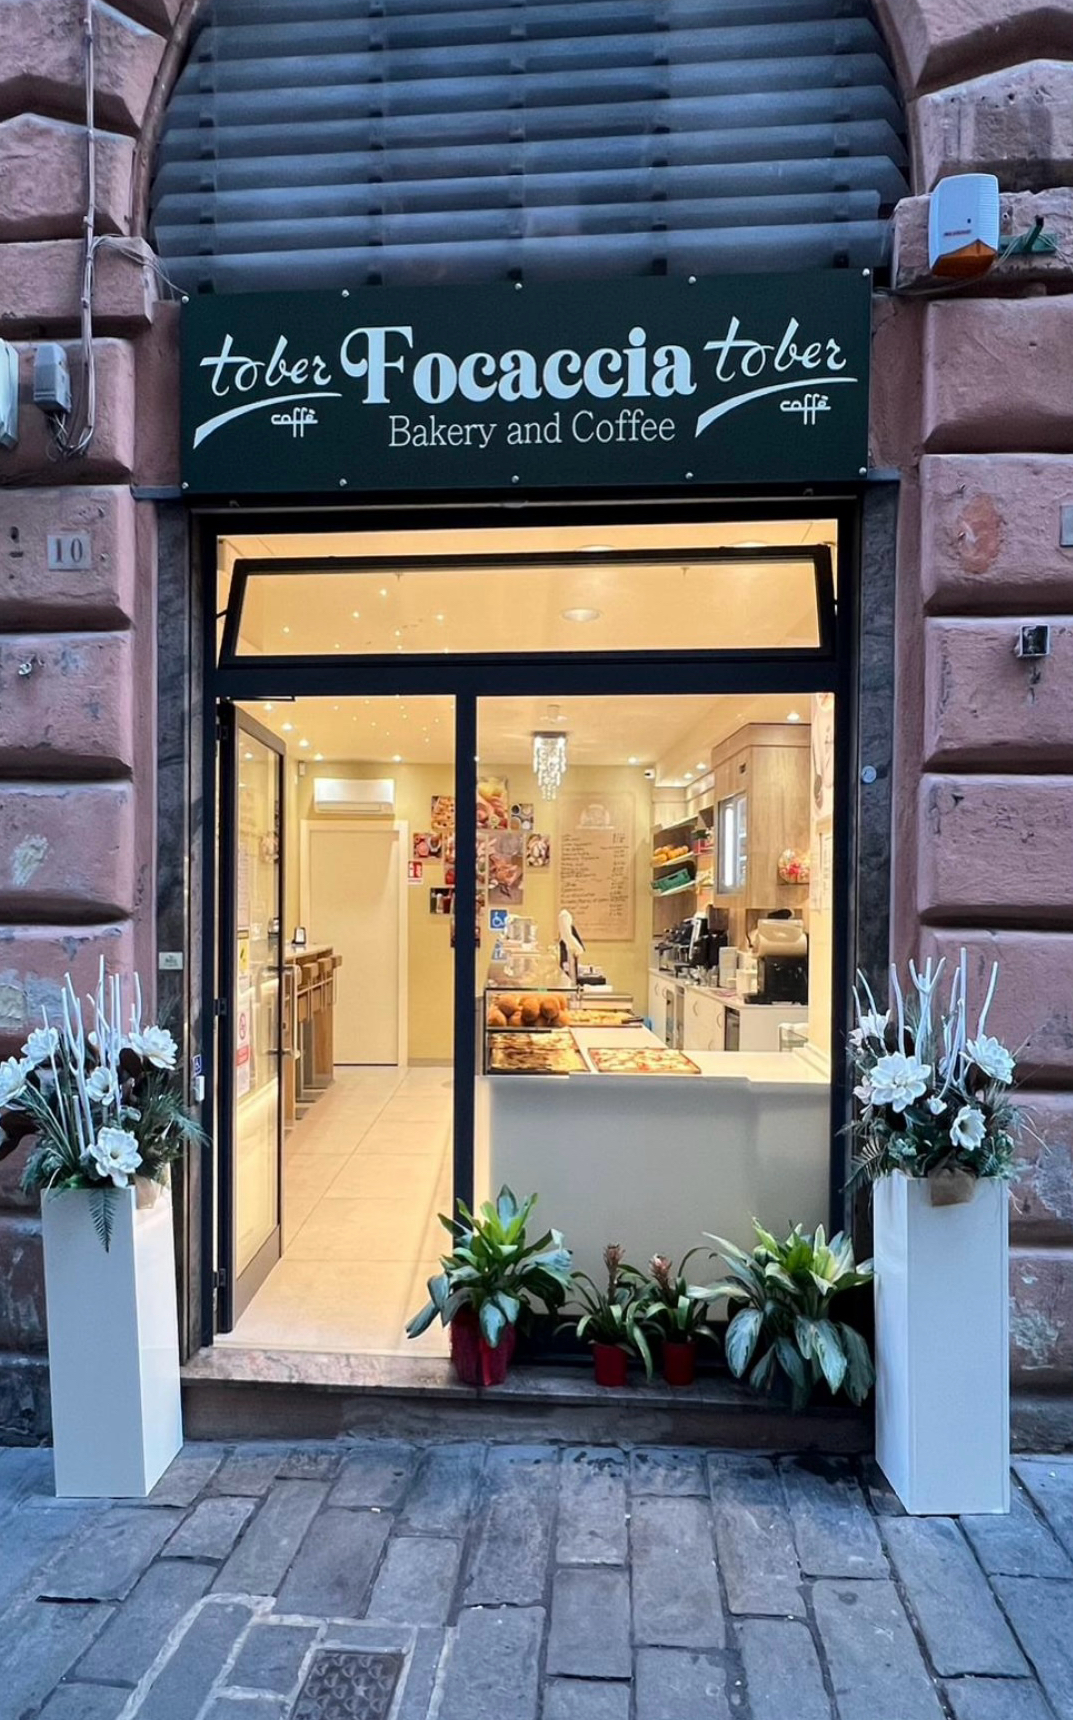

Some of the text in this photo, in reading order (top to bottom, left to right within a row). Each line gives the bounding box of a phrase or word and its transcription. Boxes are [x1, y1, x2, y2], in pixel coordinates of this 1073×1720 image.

[199, 333, 332, 397] tober
[339, 325, 698, 405] Focaccia
[703, 315, 847, 383] tober
[388, 408, 676, 449] Bakery and Coffee
[56, 538, 83, 562] 10
